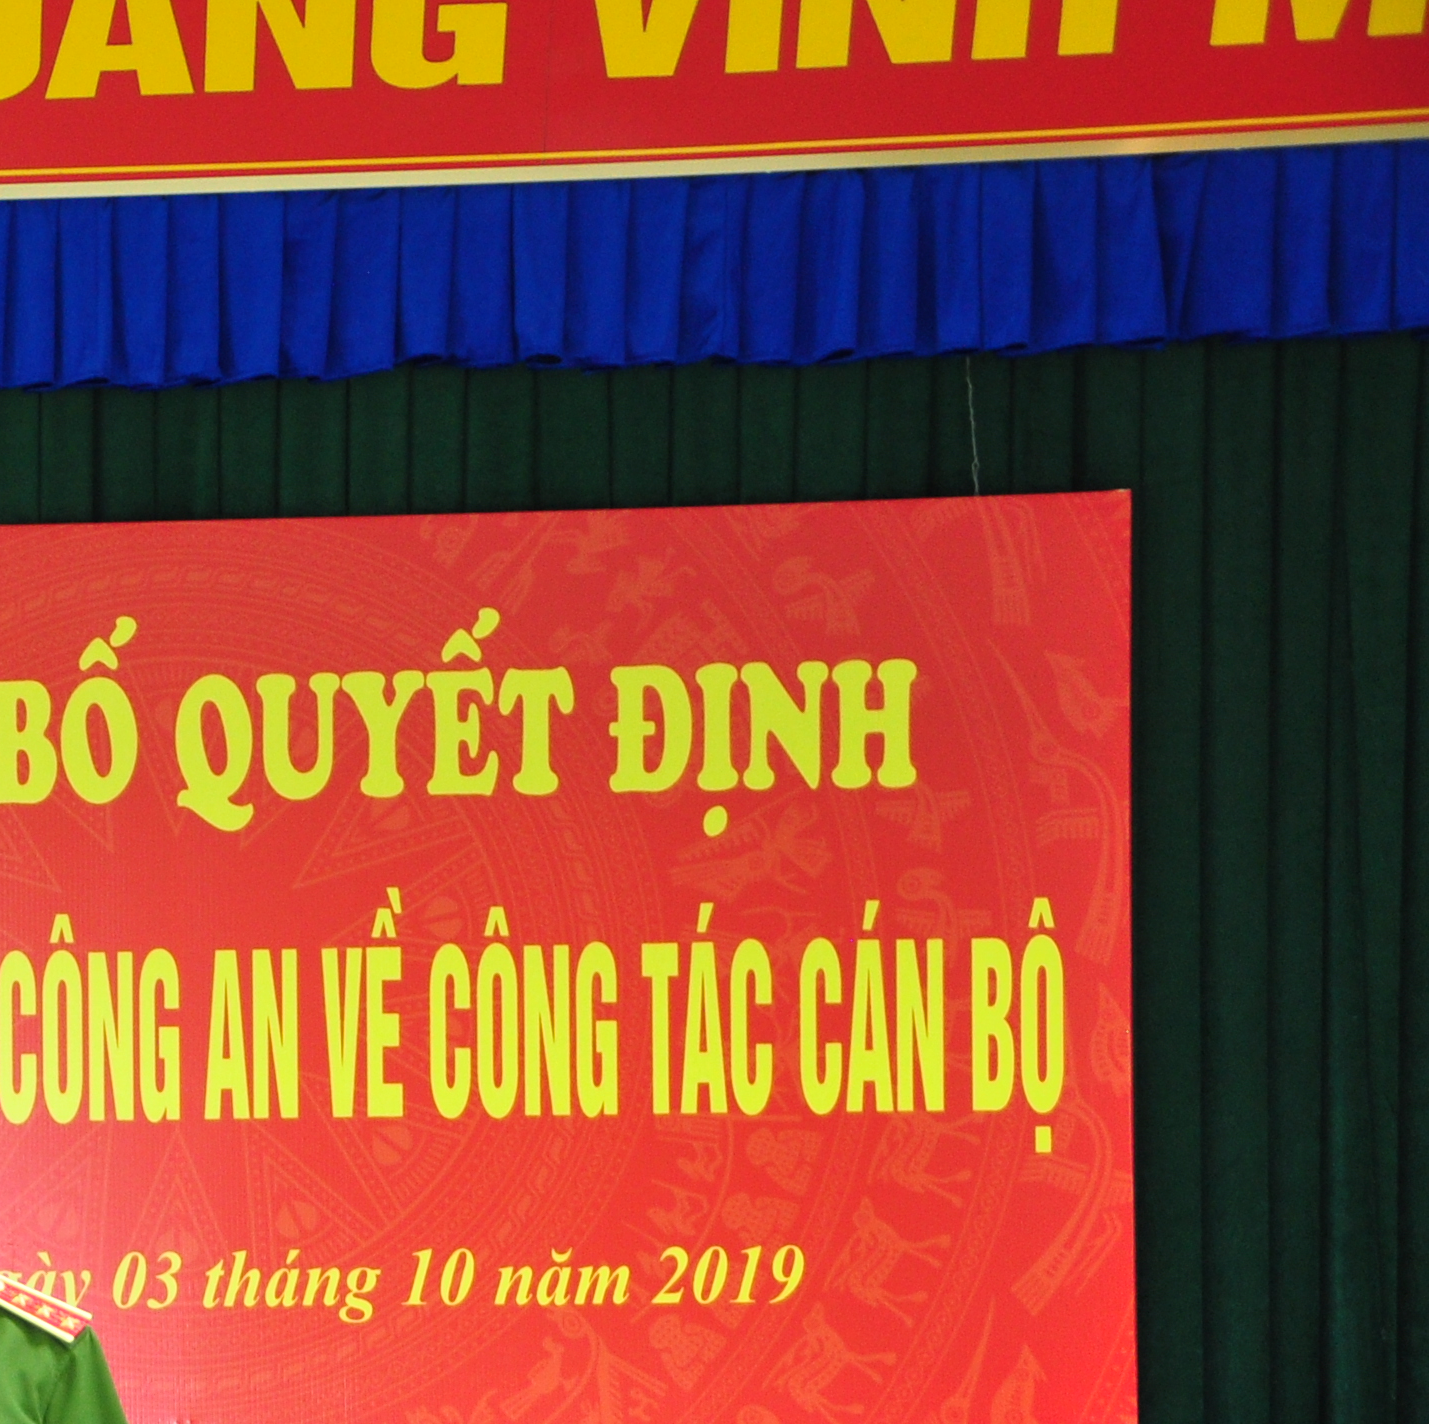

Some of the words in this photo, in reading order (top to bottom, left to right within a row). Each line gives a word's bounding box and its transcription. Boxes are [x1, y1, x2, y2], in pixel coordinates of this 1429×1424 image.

[174, 607, 576, 832] QUYẾT
[608, 658, 919, 838] ĐỊNH
[204, 948, 299, 1121] AN
[321, 886, 404, 1119] VỀ
[429, 906, 620, 1120] CÔNG
[641, 902, 775, 1116] TÁC
[799, 899, 945, 1116] CÁN
[971, 897, 1066, 1154] BỘ
[112, 1250, 183, 1311] 03
[203, 1248, 382, 1324] tháng
[404, 1247, 476, 1307] 10
[493, 1248, 631, 1307] năm
[651, 1245, 806, 1305] 2019
